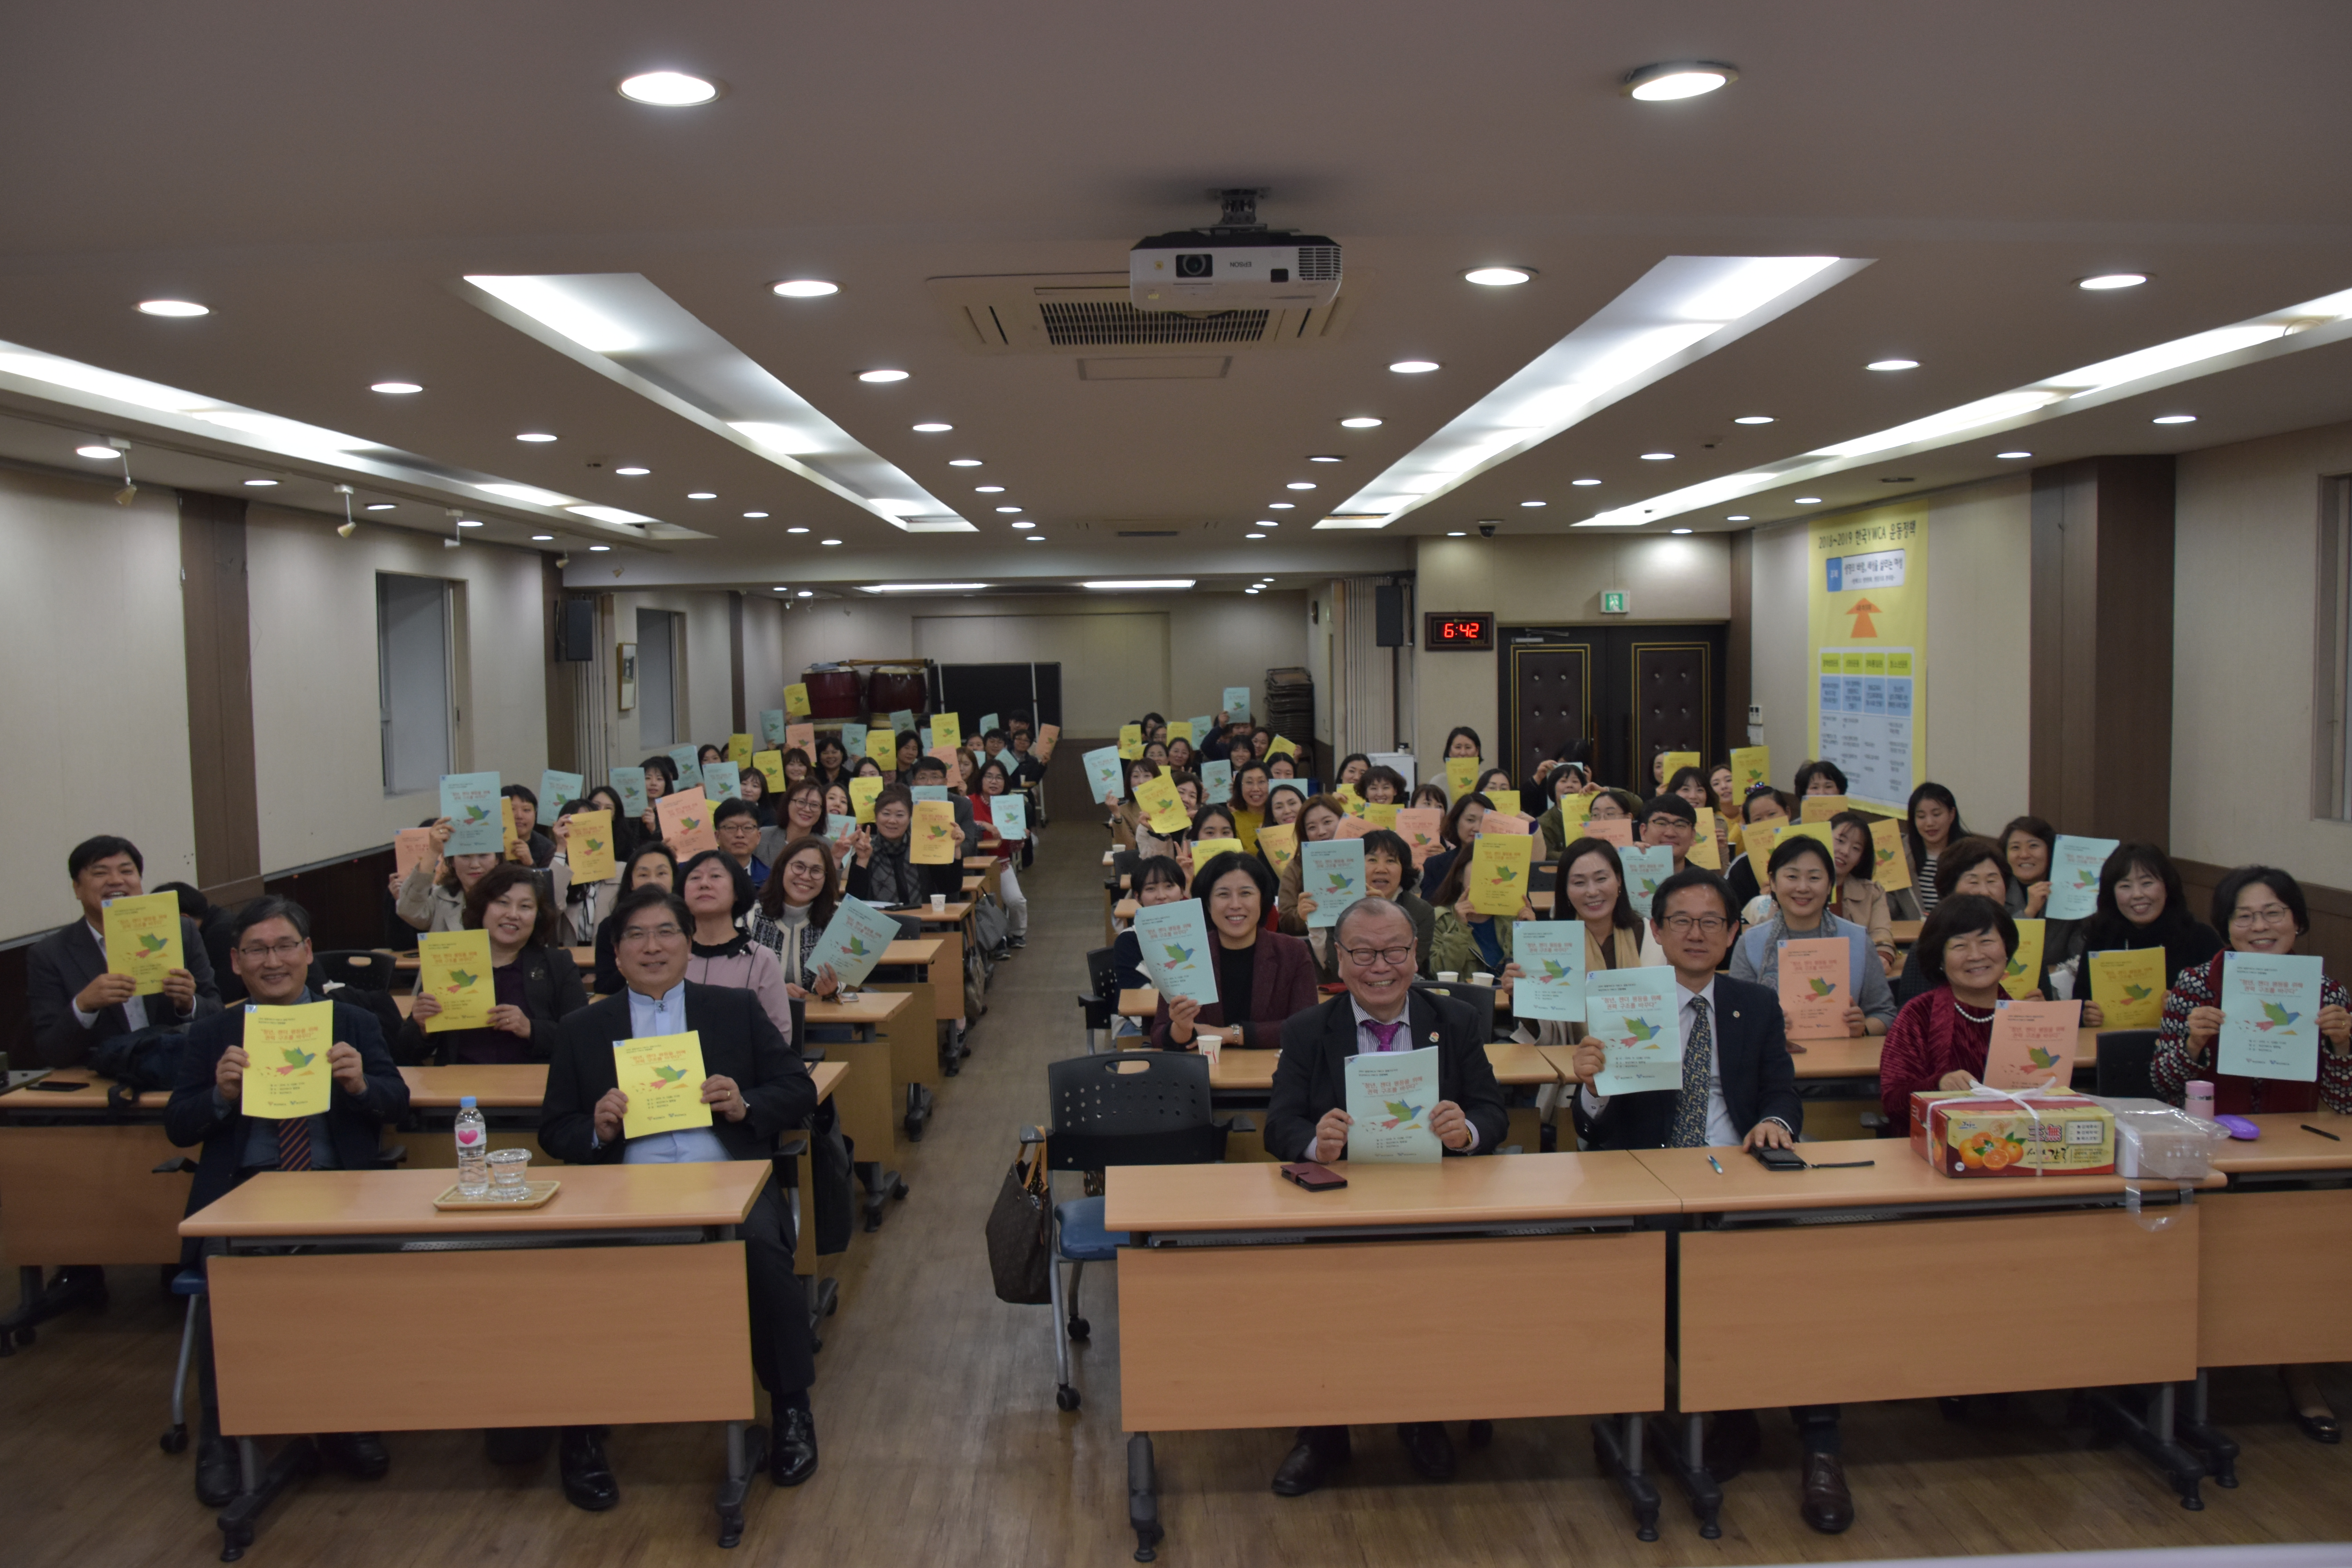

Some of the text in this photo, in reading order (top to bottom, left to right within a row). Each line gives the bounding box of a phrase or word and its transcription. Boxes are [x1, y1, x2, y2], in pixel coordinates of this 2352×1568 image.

[1855, 526, 1887, 545] 한국YWCA
[1890, 520, 1916, 540] 운동정책
[1444, 623, 1479, 638] 6:42
